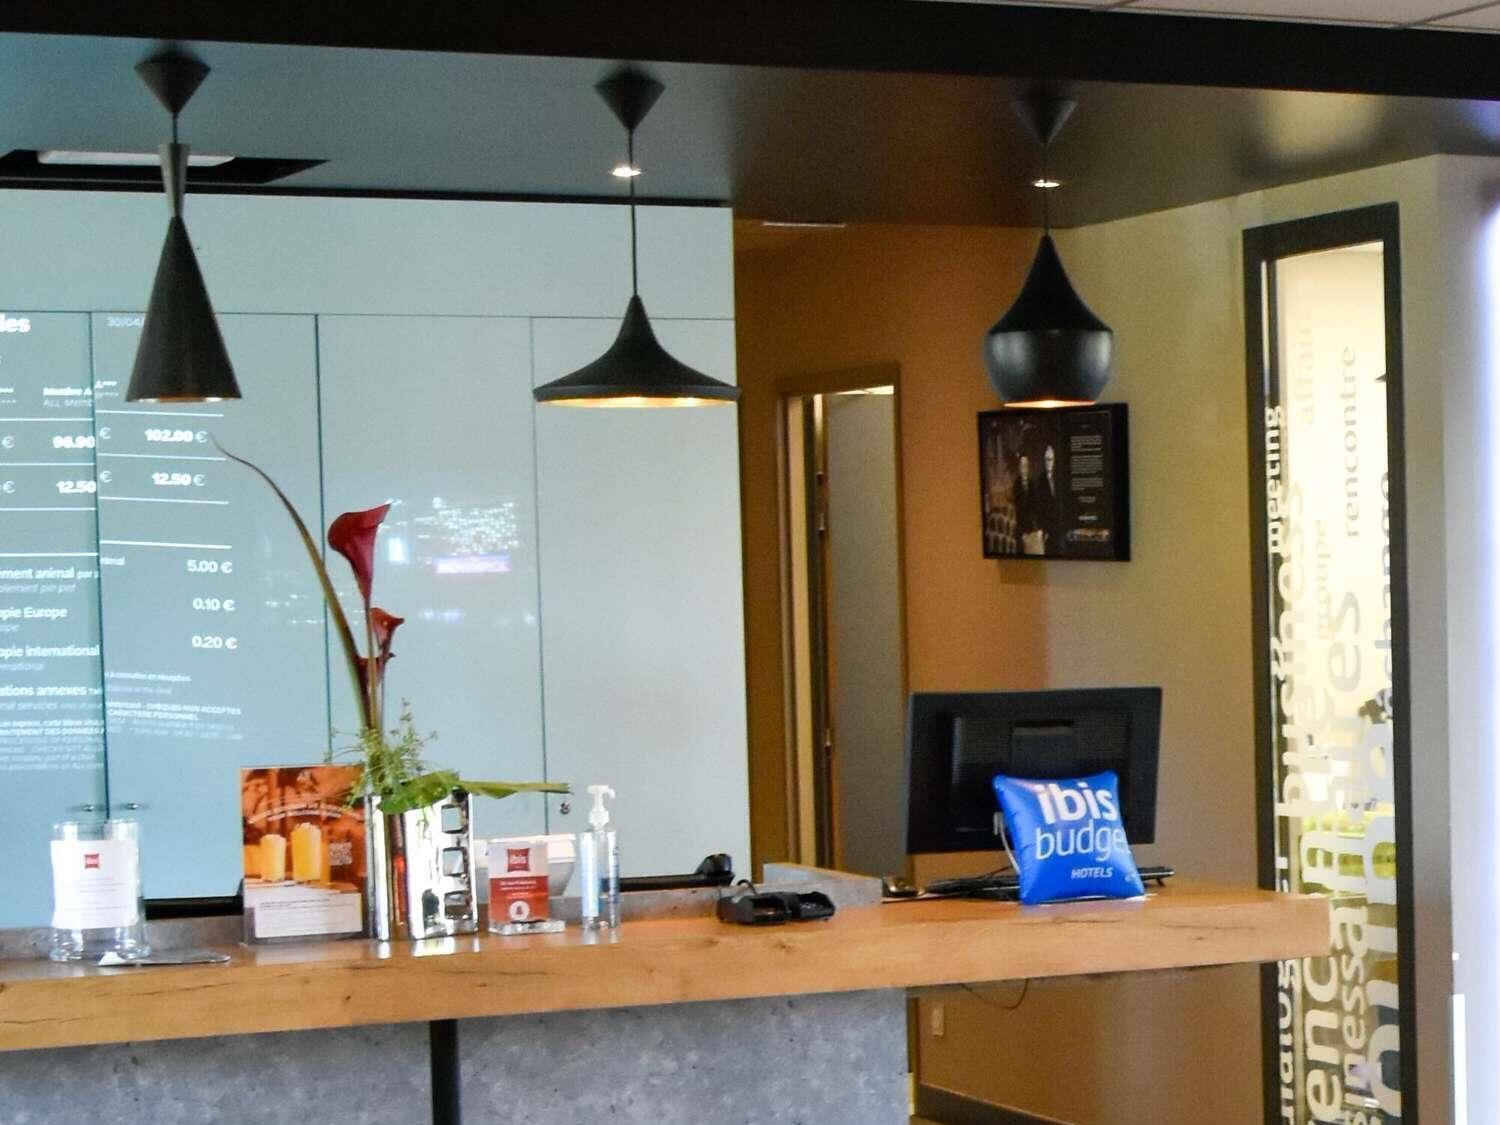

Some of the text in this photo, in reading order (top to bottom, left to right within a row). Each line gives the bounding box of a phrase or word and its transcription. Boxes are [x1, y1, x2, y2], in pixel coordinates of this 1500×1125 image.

[1340, 346, 1361, 540] rencontre
[187, 560, 233, 574] 5.00 €
[193, 598, 235, 612] 0.10 €
[23, 606, 68, 621] Europe
[192, 636, 238, 650] 0.20 €
[1035, 782, 1119, 825] ibis
[1036, 819, 1129, 862] budge
[1071, 866, 1114, 880] HOTELS
